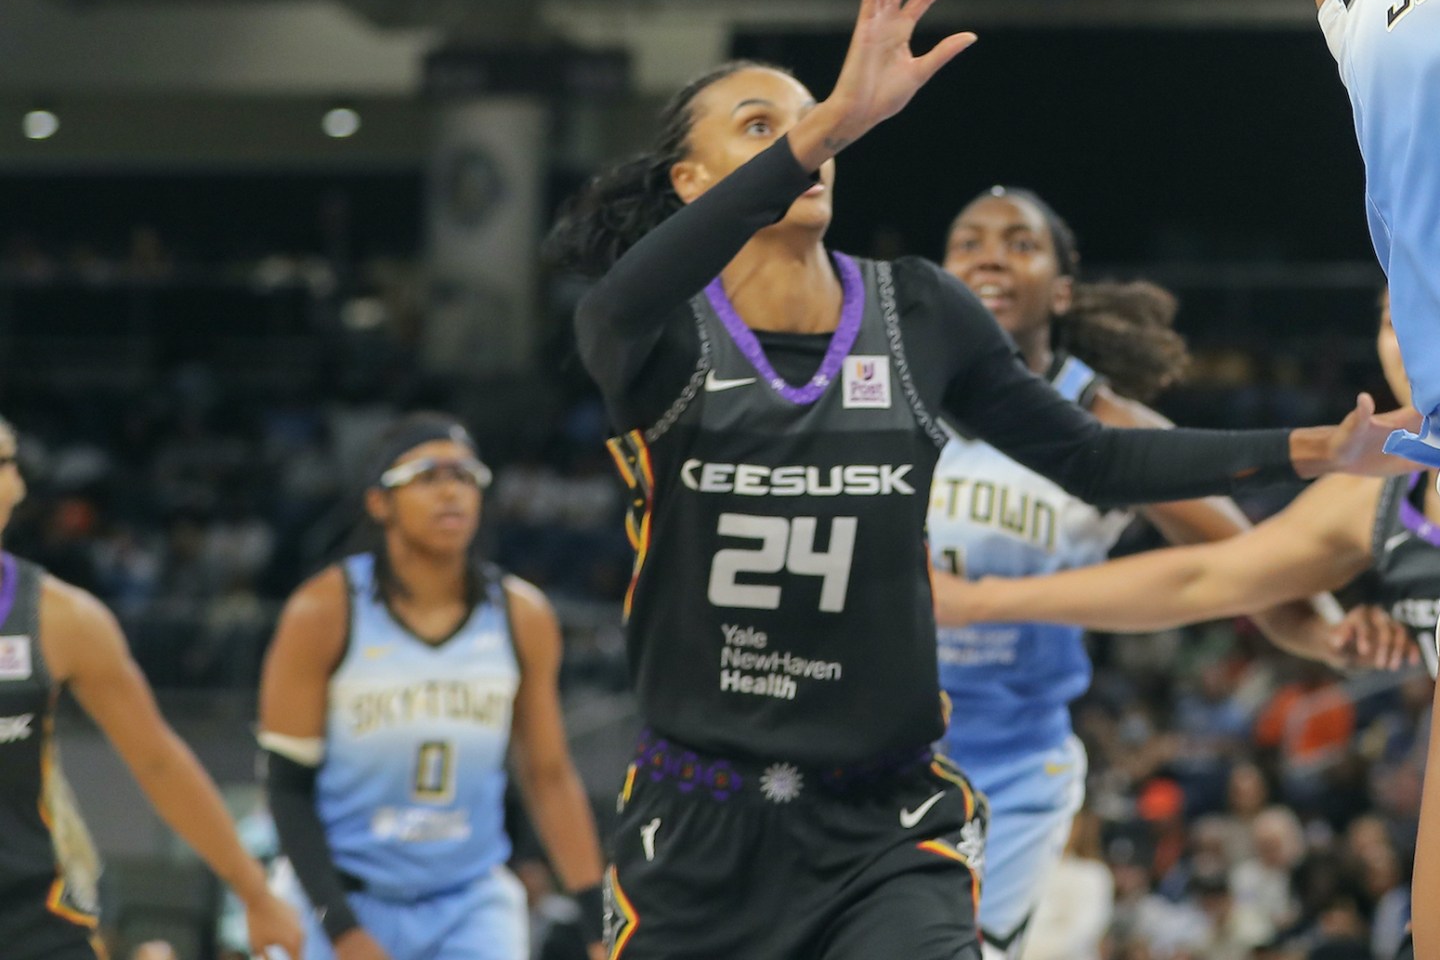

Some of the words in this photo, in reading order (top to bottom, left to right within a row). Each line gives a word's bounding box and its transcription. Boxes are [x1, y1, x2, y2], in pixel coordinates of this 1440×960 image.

[707, 512, 859, 614] 24
[721, 623, 768, 649] Yale
[720, 669, 798, 701] Health
